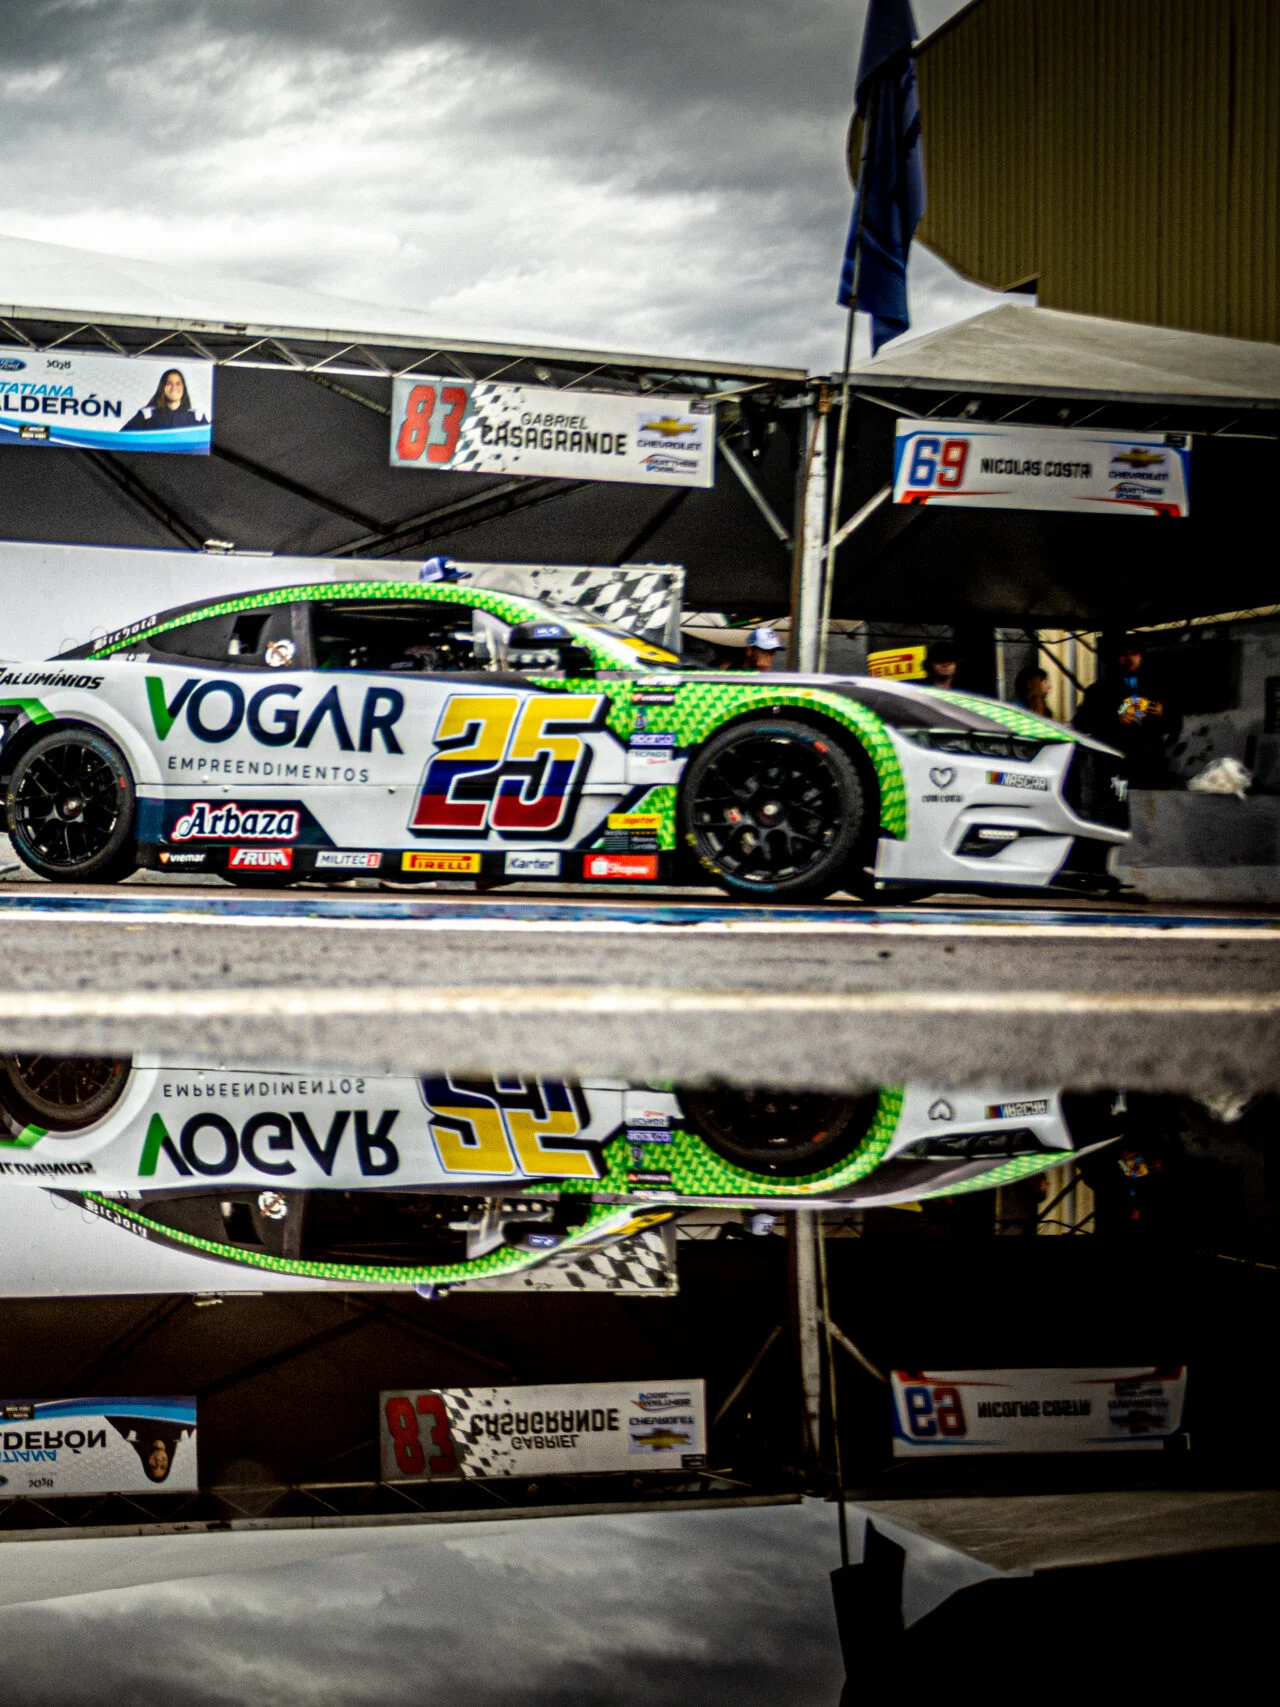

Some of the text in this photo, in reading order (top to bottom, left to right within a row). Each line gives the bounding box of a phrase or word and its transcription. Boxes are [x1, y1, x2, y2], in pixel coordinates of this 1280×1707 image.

[396, 384, 469, 464] 83
[520, 412, 589, 431] GABRIEL
[481, 422, 629, 456] CASAGRANDE
[637, 439, 702, 452] CHEVROLET
[908, 437, 969, 490] 69
[980, 458, 1093, 479] NICOLAS COSTA
[144, 675, 406, 755] VOGAR
[167, 755, 370, 783] EMPREENDIMENTOS
[408, 692, 610, 840] 25
[1002, 772, 1049, 791] NASCAR
[174, 803, 298, 840] Arbaza
[169, 851, 206, 864] viemar
[231, 848, 289, 868] FRUM
[410, 854, 472, 871] PIRELLI
[507, 856, 555, 872] Karter
